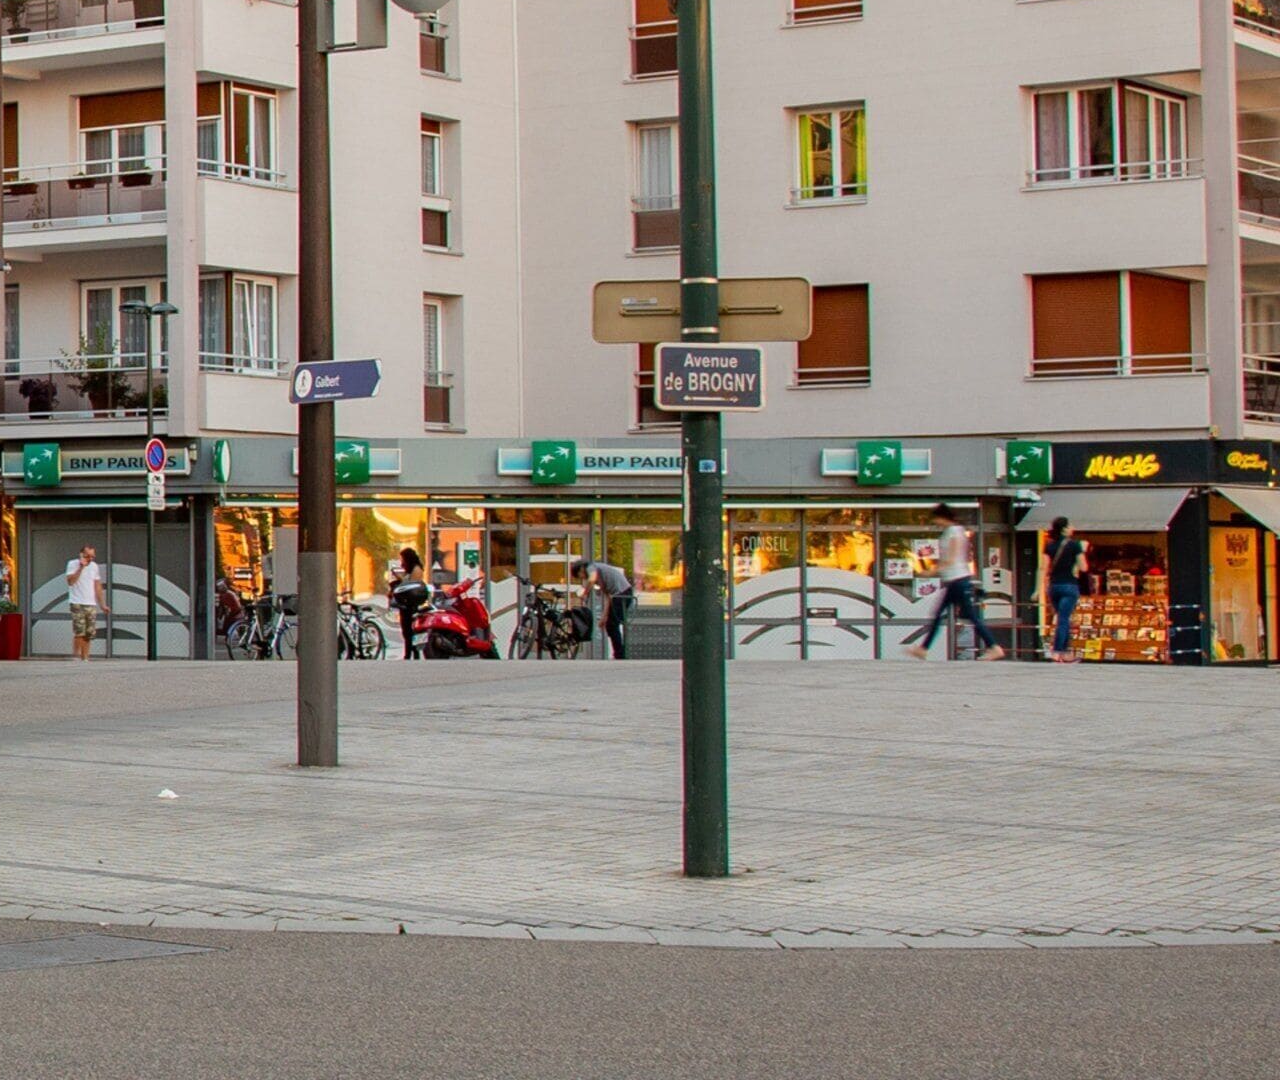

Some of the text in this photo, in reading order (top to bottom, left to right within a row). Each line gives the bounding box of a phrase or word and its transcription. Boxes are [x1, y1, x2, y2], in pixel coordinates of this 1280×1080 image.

[683, 352, 739, 368] Avenue
[315, 375, 340, 388] Galbert
[664, 371, 756, 392] de BROGNY
[70, 456, 177, 469] BNP PARIS
[583, 456, 625, 467] BNP
[742, 536, 790, 552] CONSEIL
